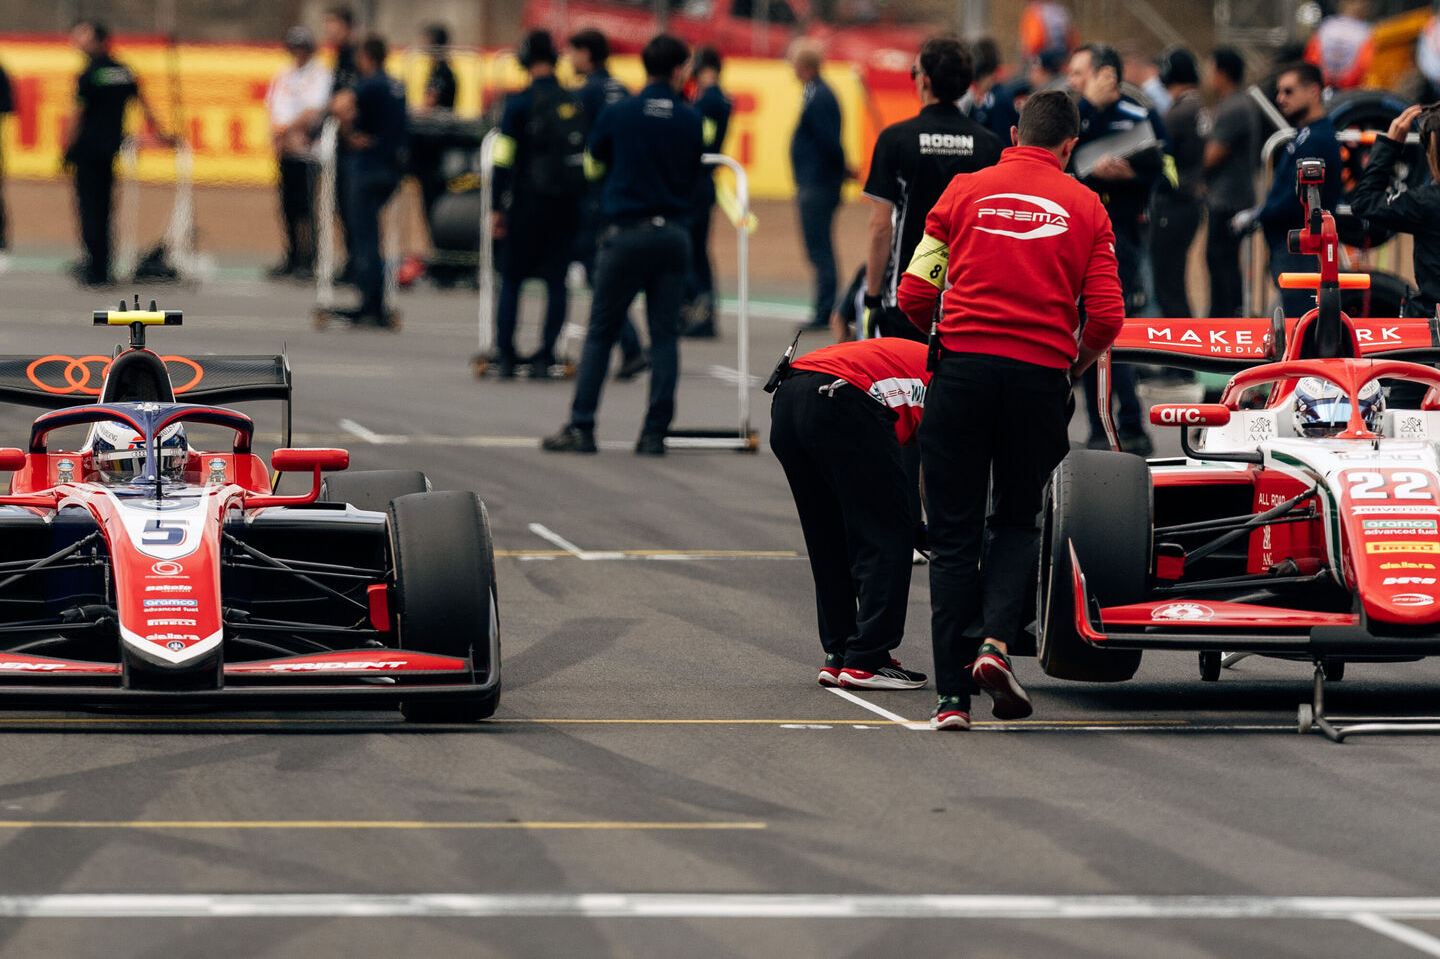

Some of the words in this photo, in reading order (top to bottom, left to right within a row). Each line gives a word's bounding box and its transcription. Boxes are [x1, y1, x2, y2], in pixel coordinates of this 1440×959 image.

[919, 133, 974, 149] RODIN
[978, 207, 1069, 227] PREMA
[930, 264, 942, 279] 8
[1211, 345, 1263, 354] MEDIA
[1347, 471, 1434, 500] 22
[1258, 492, 1270, 506] ALL
[142, 519, 190, 546] 5
[1379, 561, 1437, 570] dallara
[146, 599, 196, 607] aramco
[146, 633, 200, 641] dallara
[268, 661, 408, 671] TRIDENT
